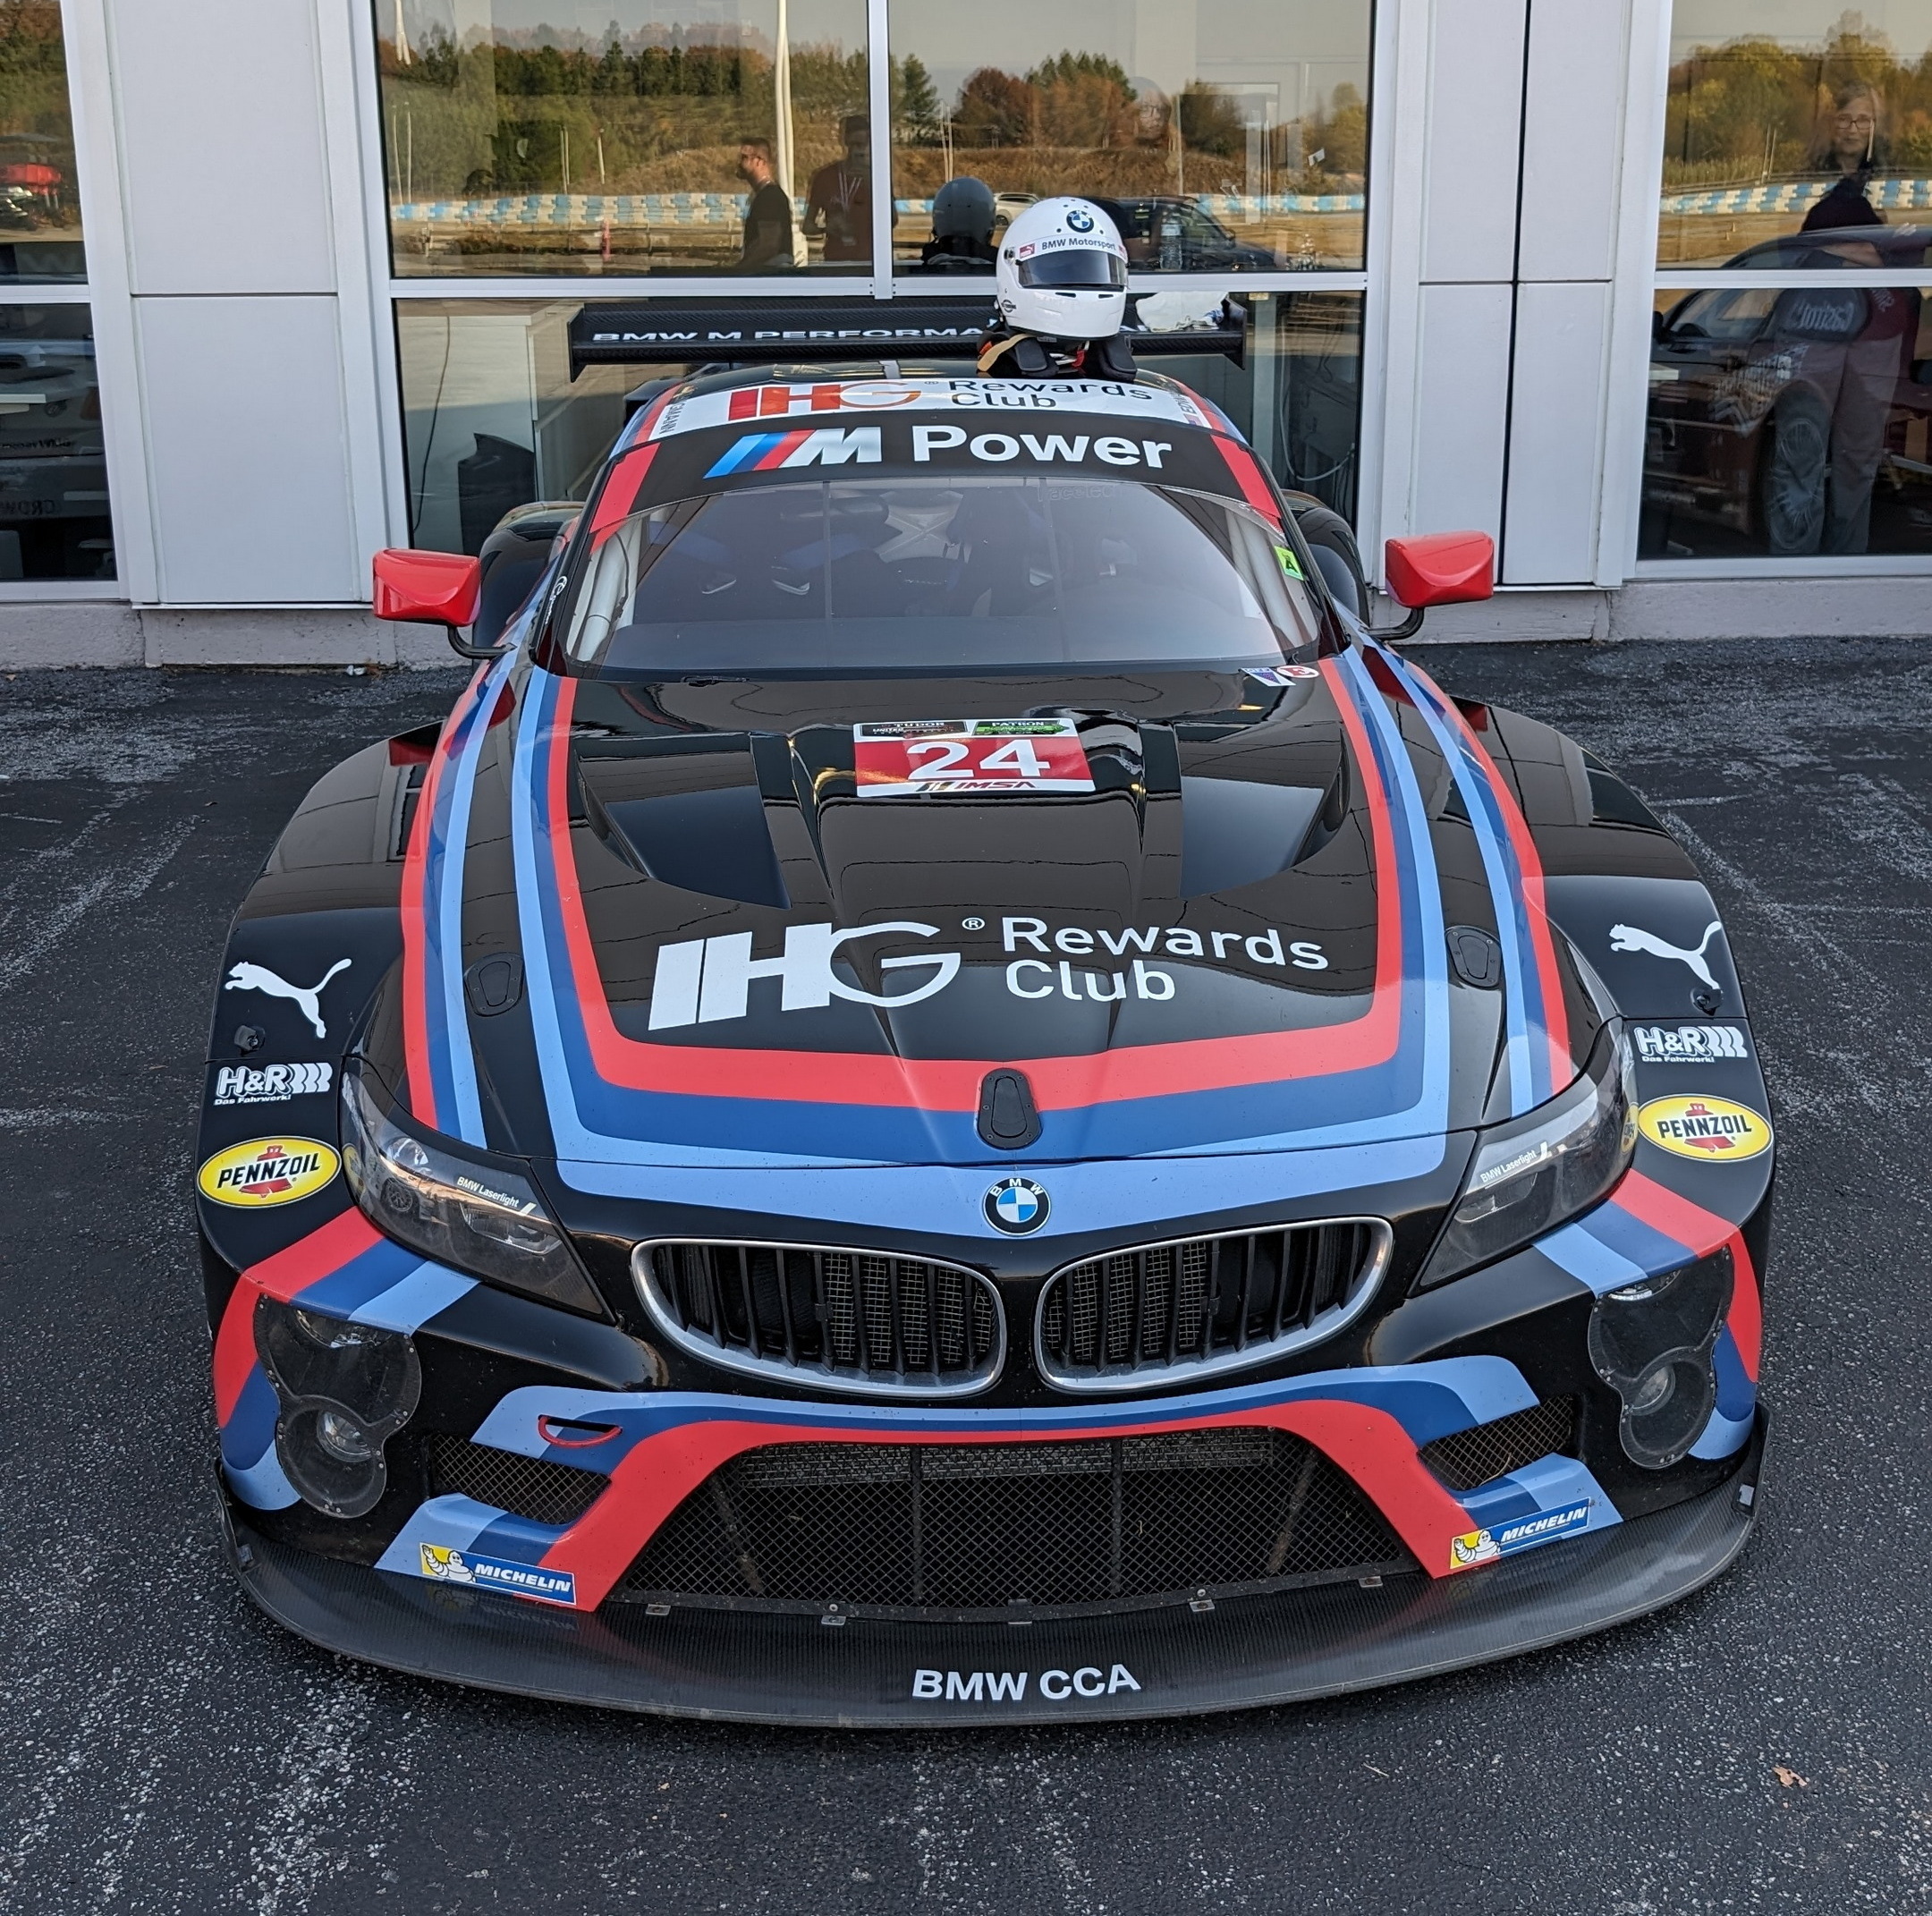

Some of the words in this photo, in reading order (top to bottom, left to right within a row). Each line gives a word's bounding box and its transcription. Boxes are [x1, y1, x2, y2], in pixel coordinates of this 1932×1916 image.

[1041, 238, 1066, 251] BMW
[1068, 237, 1117, 250] Motorsport
[592, 331, 699, 342] BMW
[707, 331, 742, 341] M
[754, 327, 984, 340] PERFORMA
[729, 380, 921, 420] IHG
[949, 379, 1152, 401] Rewards
[952, 392, 1057, 411] Club
[913, 426, 1173, 468] Power
[907, 739, 1050, 779] 24
[954, 781, 1037, 790] IMSA
[648, 920, 961, 1030] IHG
[1002, 916, 1330, 971] Rewards
[1005, 960, 1177, 1002] Club
[1634, 1026, 1714, 1056] H&R
[216, 1064, 293, 1098] H&R
[1657, 1115, 1753, 1139] PENNZOIL
[216, 1153, 321, 1190] PENNZOIL
[1479, 1167, 1502, 1183] BMW
[1502, 1149, 1538, 1173] Laserlight
[456, 1176, 481, 1192] BMW
[479, 1184, 520, 1208] Laserlight
[1500, 1505, 1588, 1543] MICHELIN
[474, 1563, 572, 1592] MICHELIN
[911, 1668, 1029, 1700] BMW
[1039, 1664, 1142, 1700] CCA
